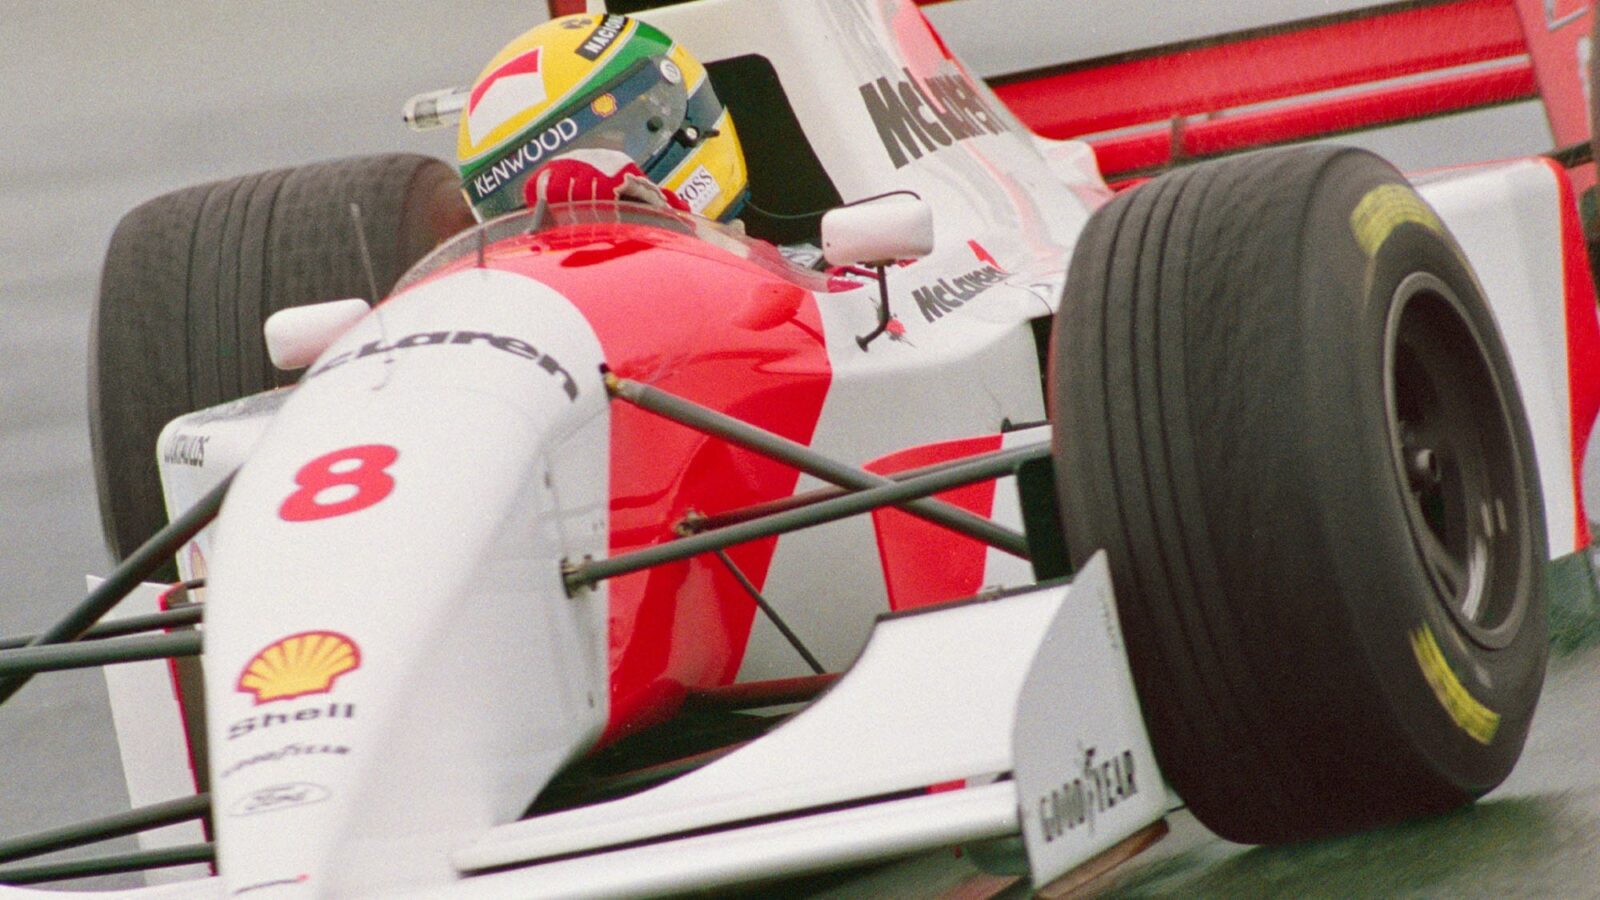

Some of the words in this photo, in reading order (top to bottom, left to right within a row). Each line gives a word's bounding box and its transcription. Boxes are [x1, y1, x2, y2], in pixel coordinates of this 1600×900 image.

[473, 117, 578, 197] KENWOOD
[278, 444, 400, 522] 8
[228, 703, 355, 740] Shell
